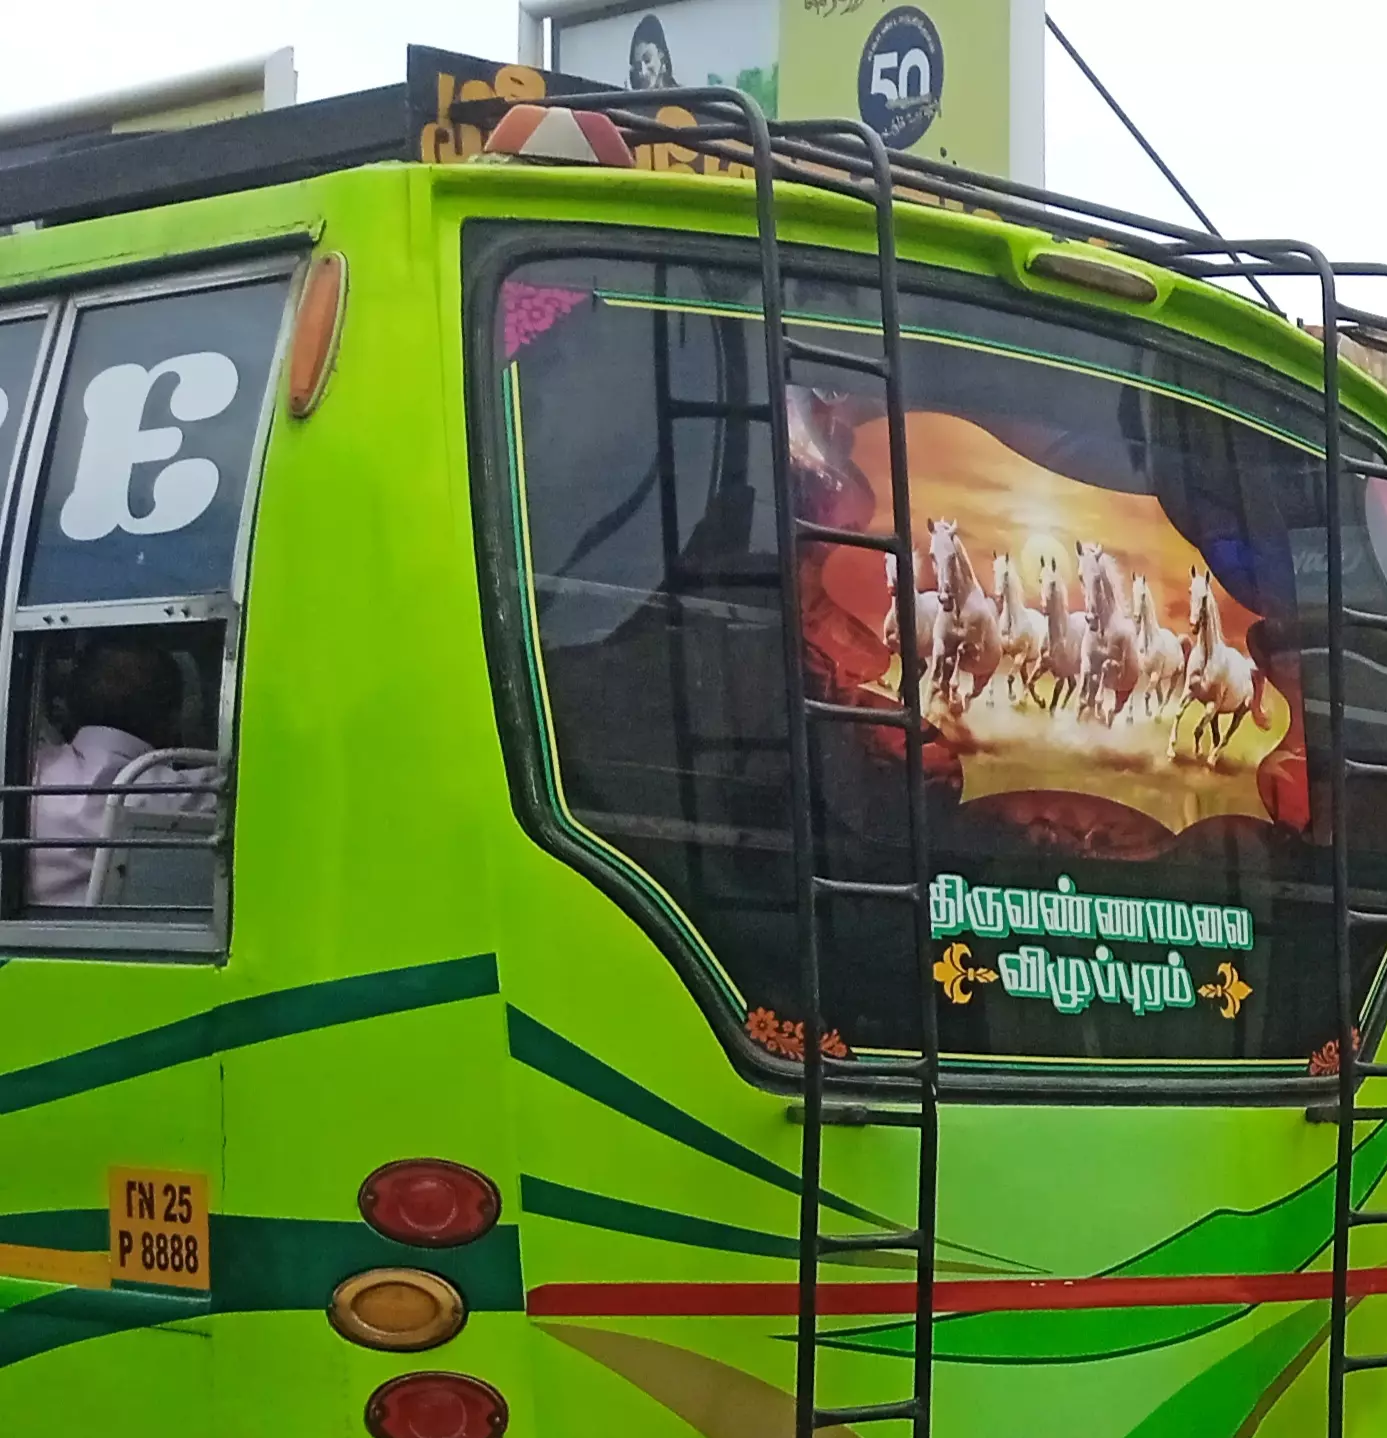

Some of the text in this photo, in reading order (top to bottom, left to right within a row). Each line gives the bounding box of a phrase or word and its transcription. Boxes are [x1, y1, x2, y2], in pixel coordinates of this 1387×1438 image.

[871, 48, 930, 104] 50
[929, 873, 1254, 950] திருவண்ணாமலை
[997, 944, 1197, 1016] விழுப்புரம்
[126, 1180, 192, 1224] TN 25
[119, 1229, 198, 1274] P 8888
